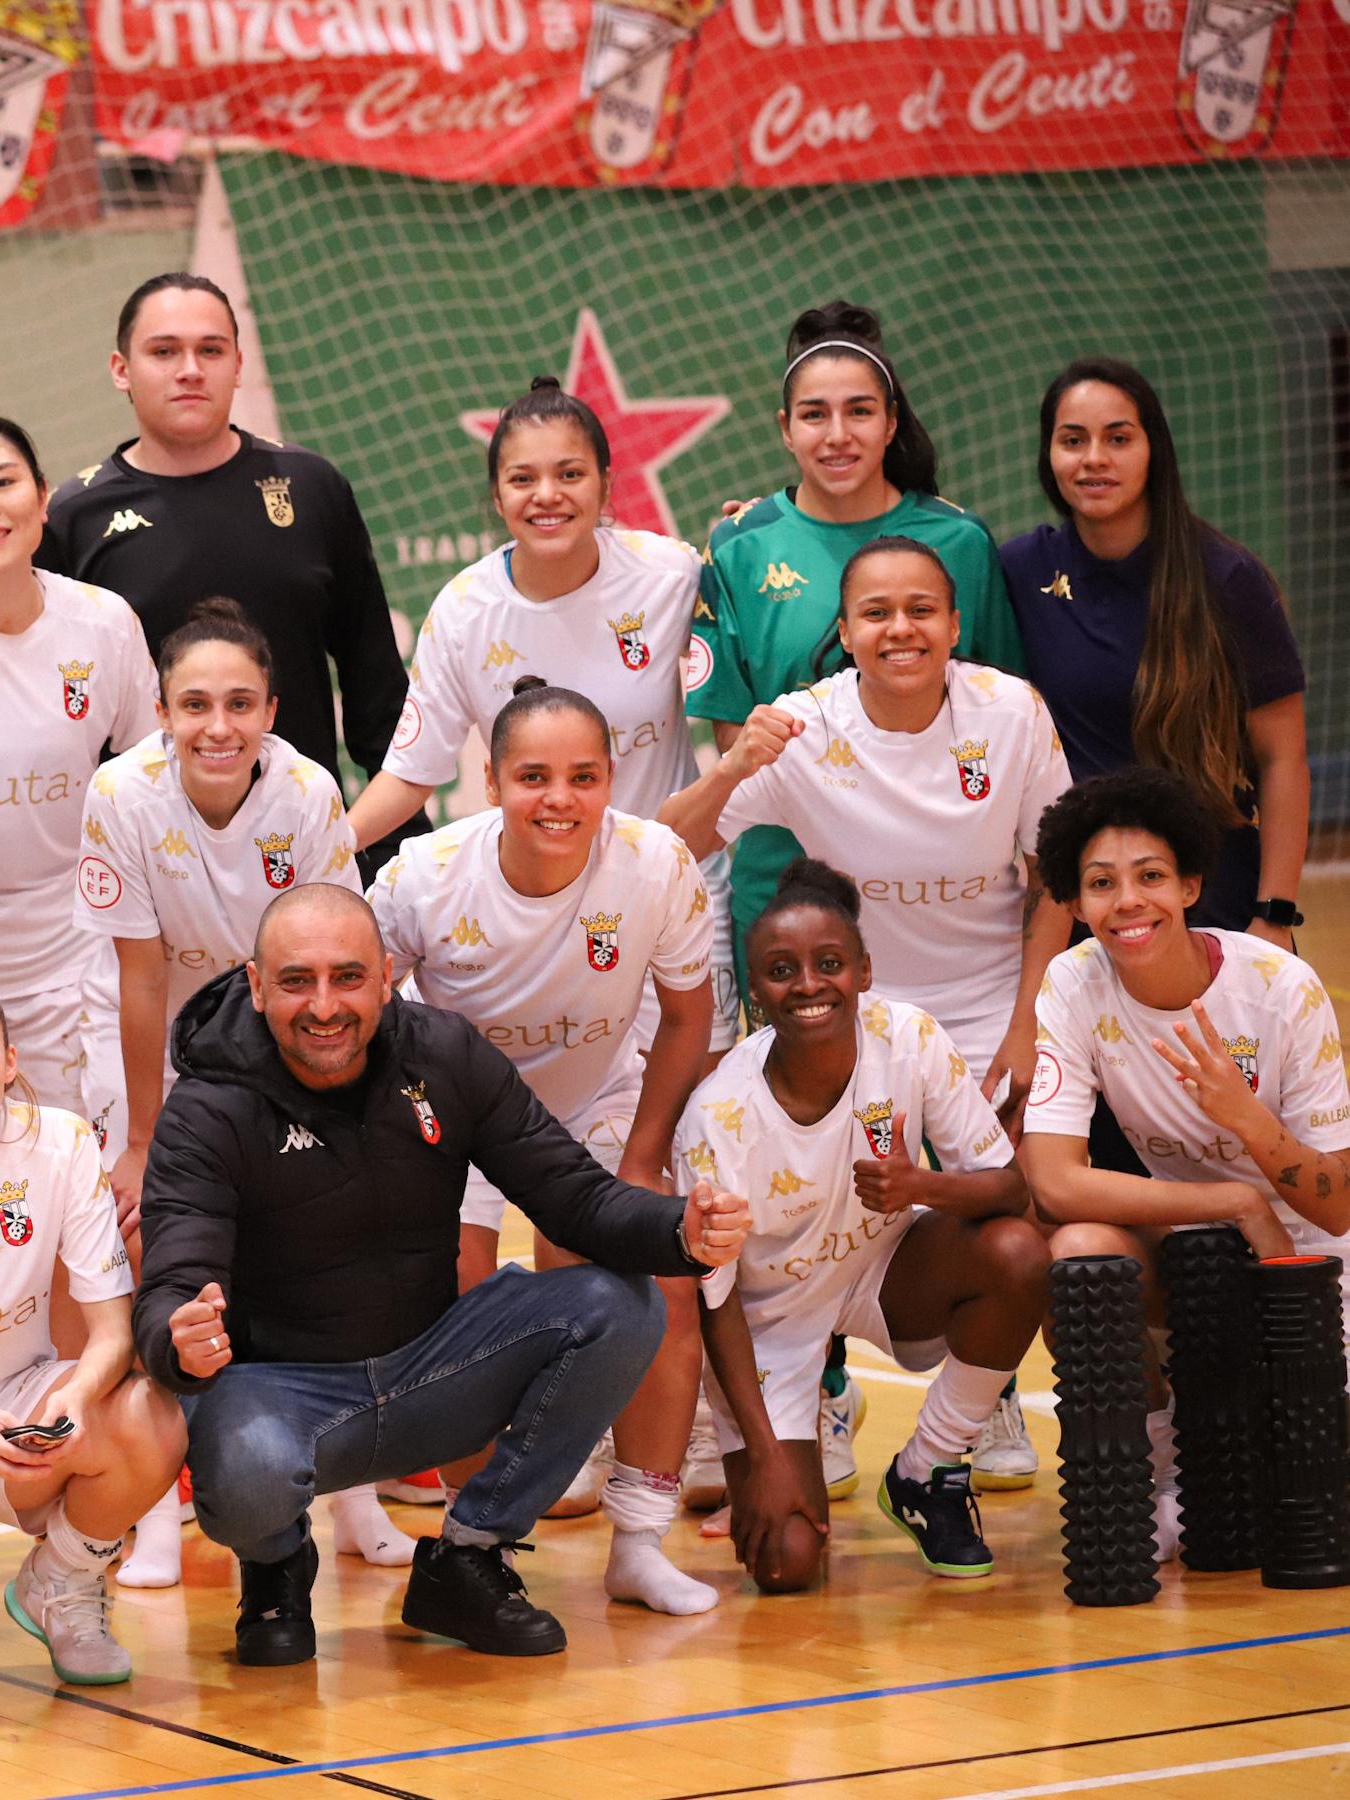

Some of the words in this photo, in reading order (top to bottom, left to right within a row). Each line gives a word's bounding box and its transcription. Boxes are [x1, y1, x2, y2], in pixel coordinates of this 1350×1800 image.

[750, 85, 875, 166] Con
[899, 68, 945, 134] el
[861, 875, 986, 905] euta
[485, 1015, 612, 1050] euta
